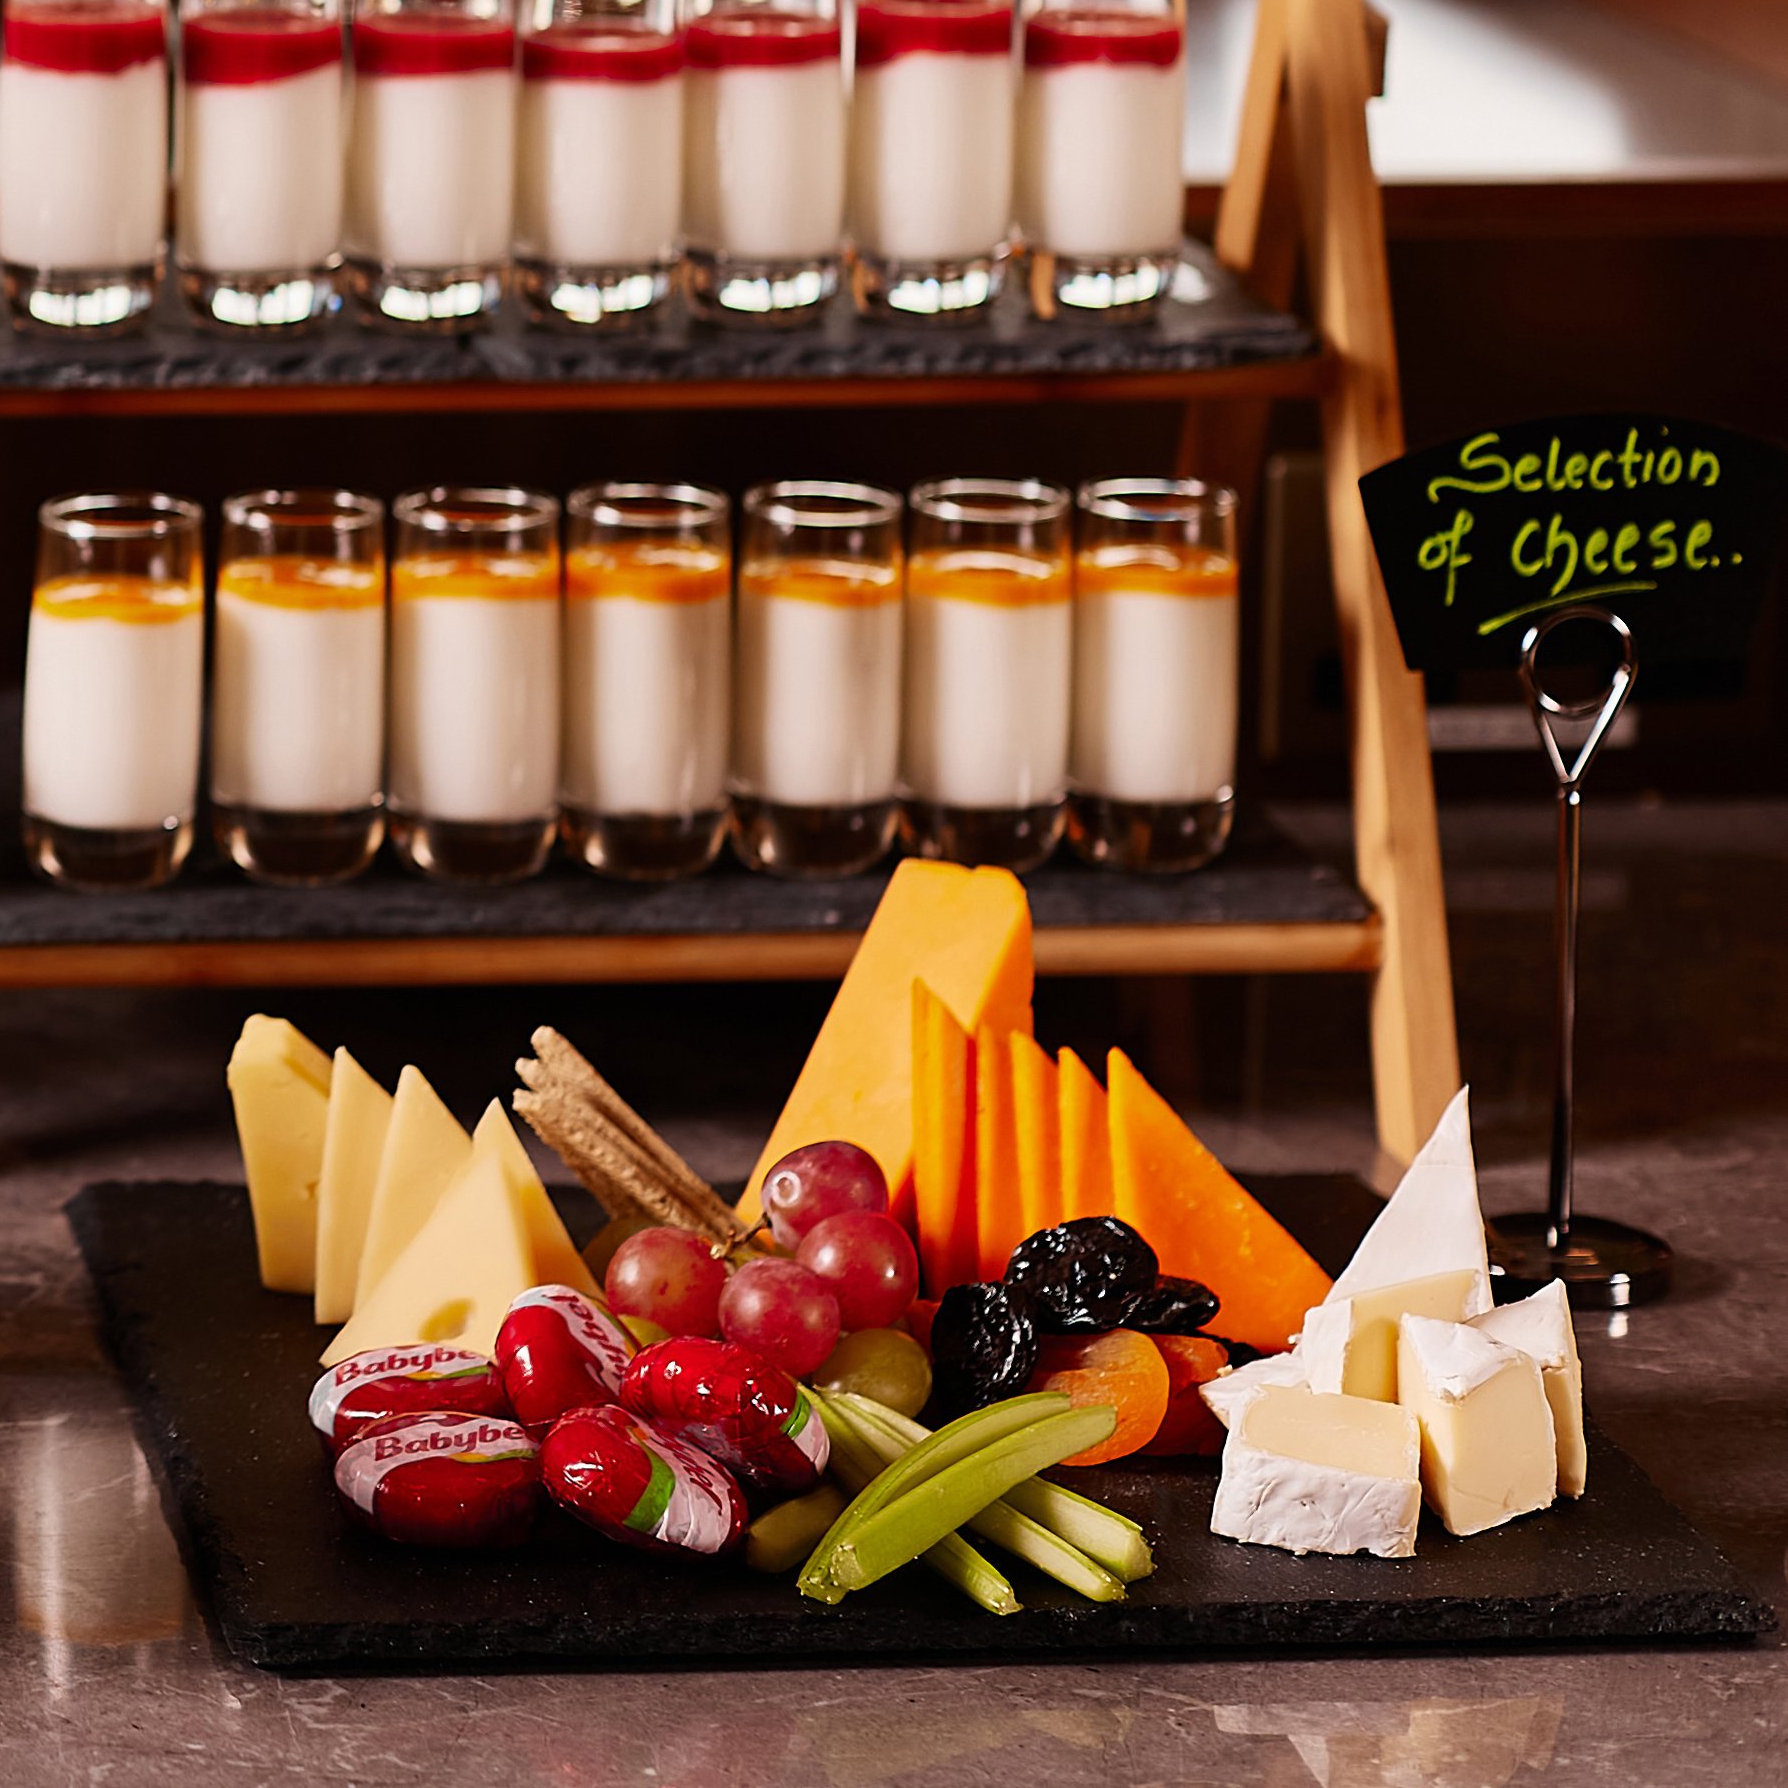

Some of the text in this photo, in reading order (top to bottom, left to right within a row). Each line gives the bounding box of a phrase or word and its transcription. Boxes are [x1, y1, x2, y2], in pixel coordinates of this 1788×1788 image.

[1427, 427, 1721, 503] Selection
[1417, 509, 1473, 606] of
[335, 1347, 476, 1387] Babybe
[374, 1423, 526, 1462] Babybe
